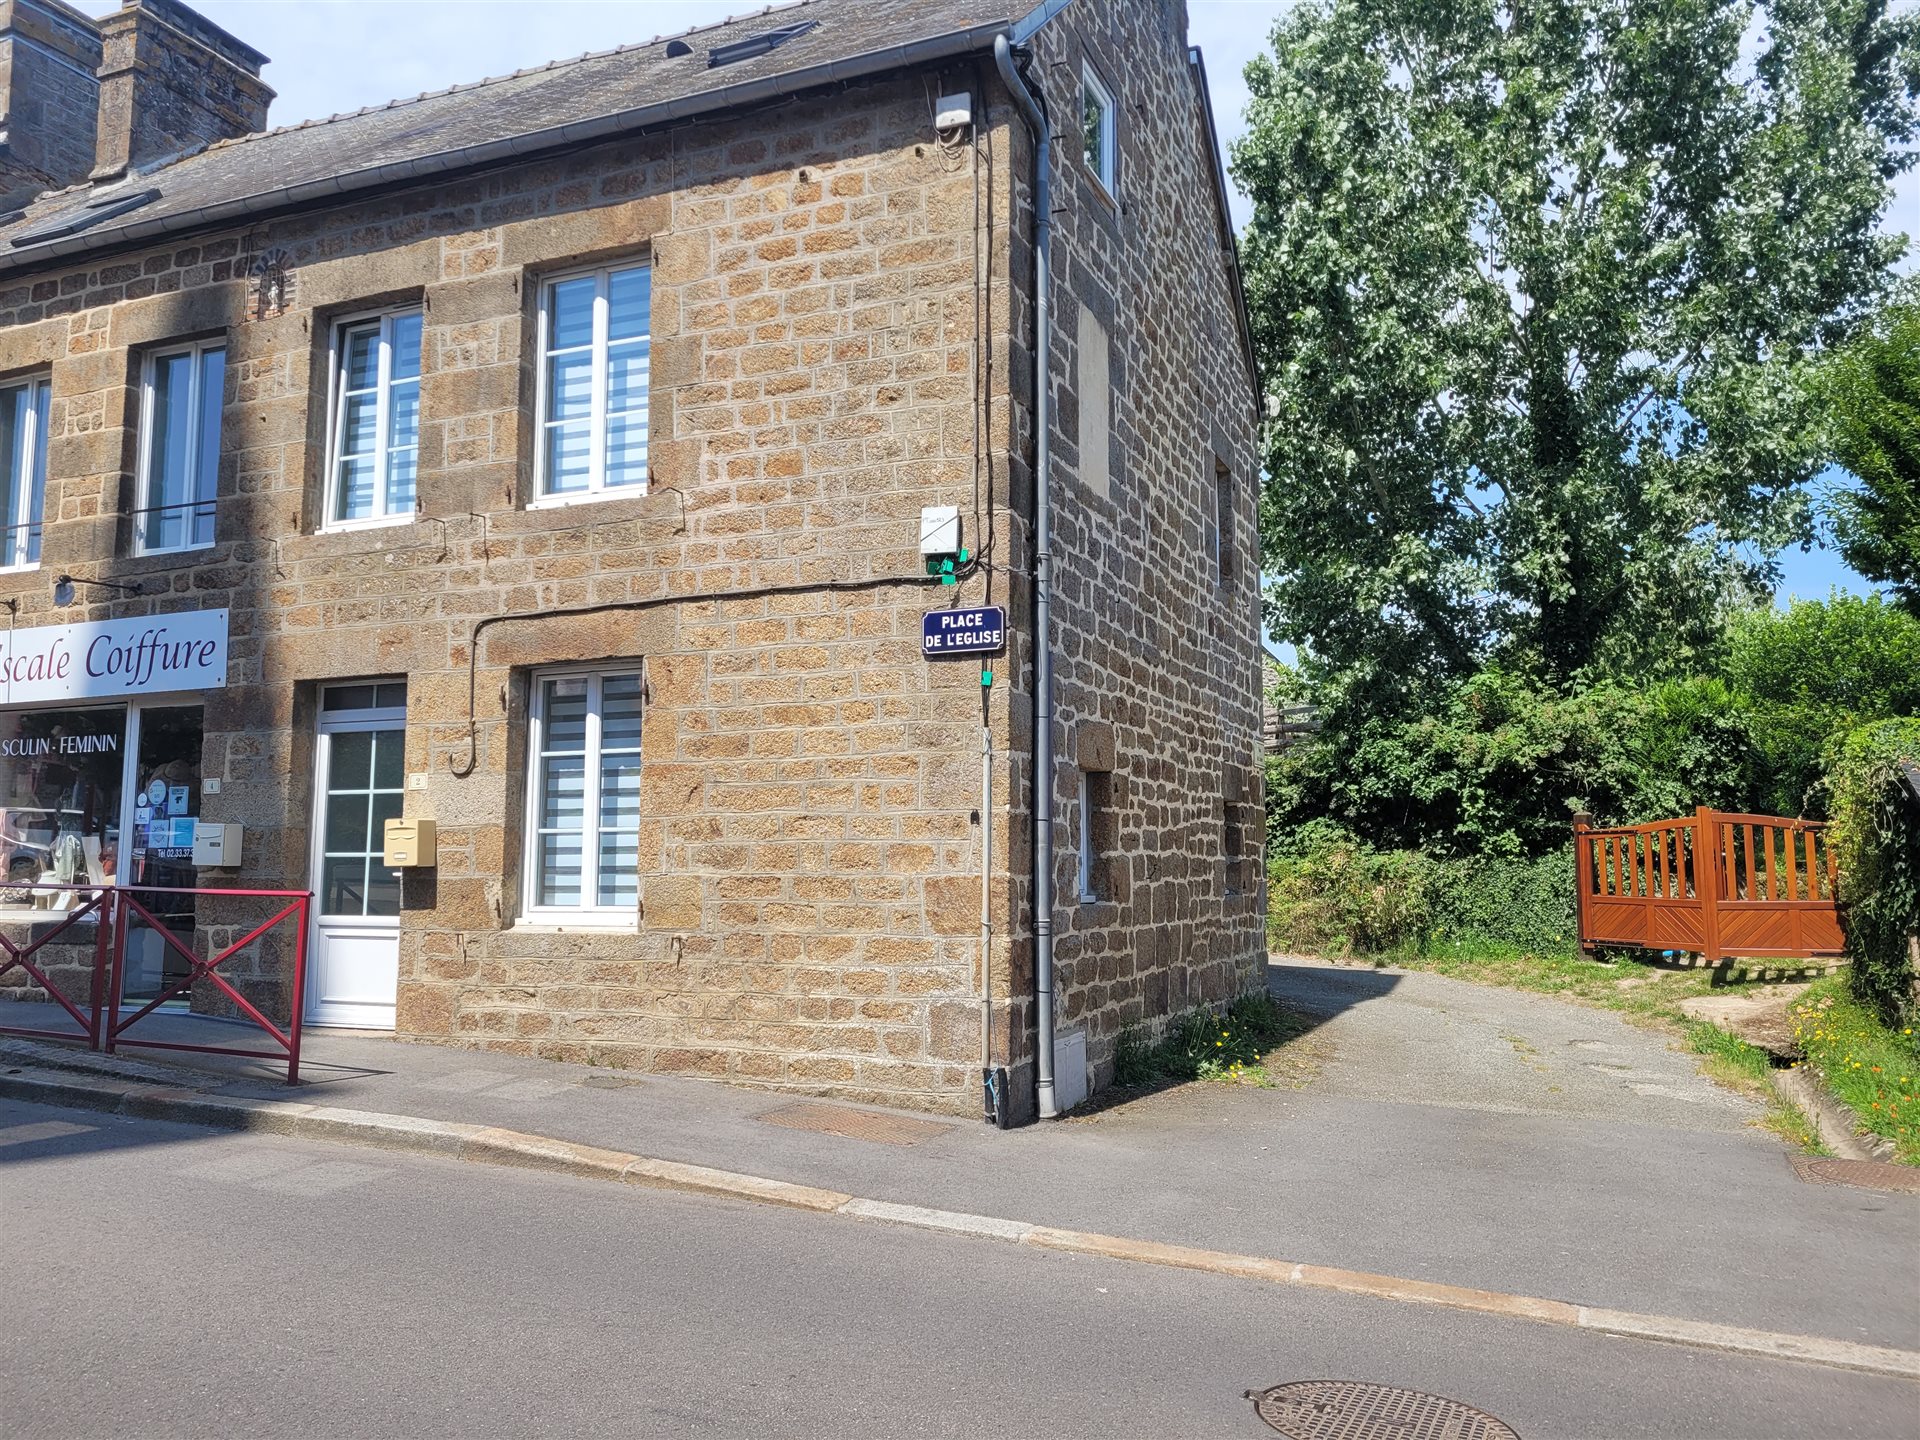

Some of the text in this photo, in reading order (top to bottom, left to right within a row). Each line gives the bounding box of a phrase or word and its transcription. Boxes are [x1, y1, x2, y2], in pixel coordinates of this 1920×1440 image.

[941, 613, 983, 628] PLACE
[925, 630, 1001, 648] DE L'EGLISE
[0, 628, 216, 687] scale Coiffure
[0, 734, 117, 756] SCULIN FEMININ
